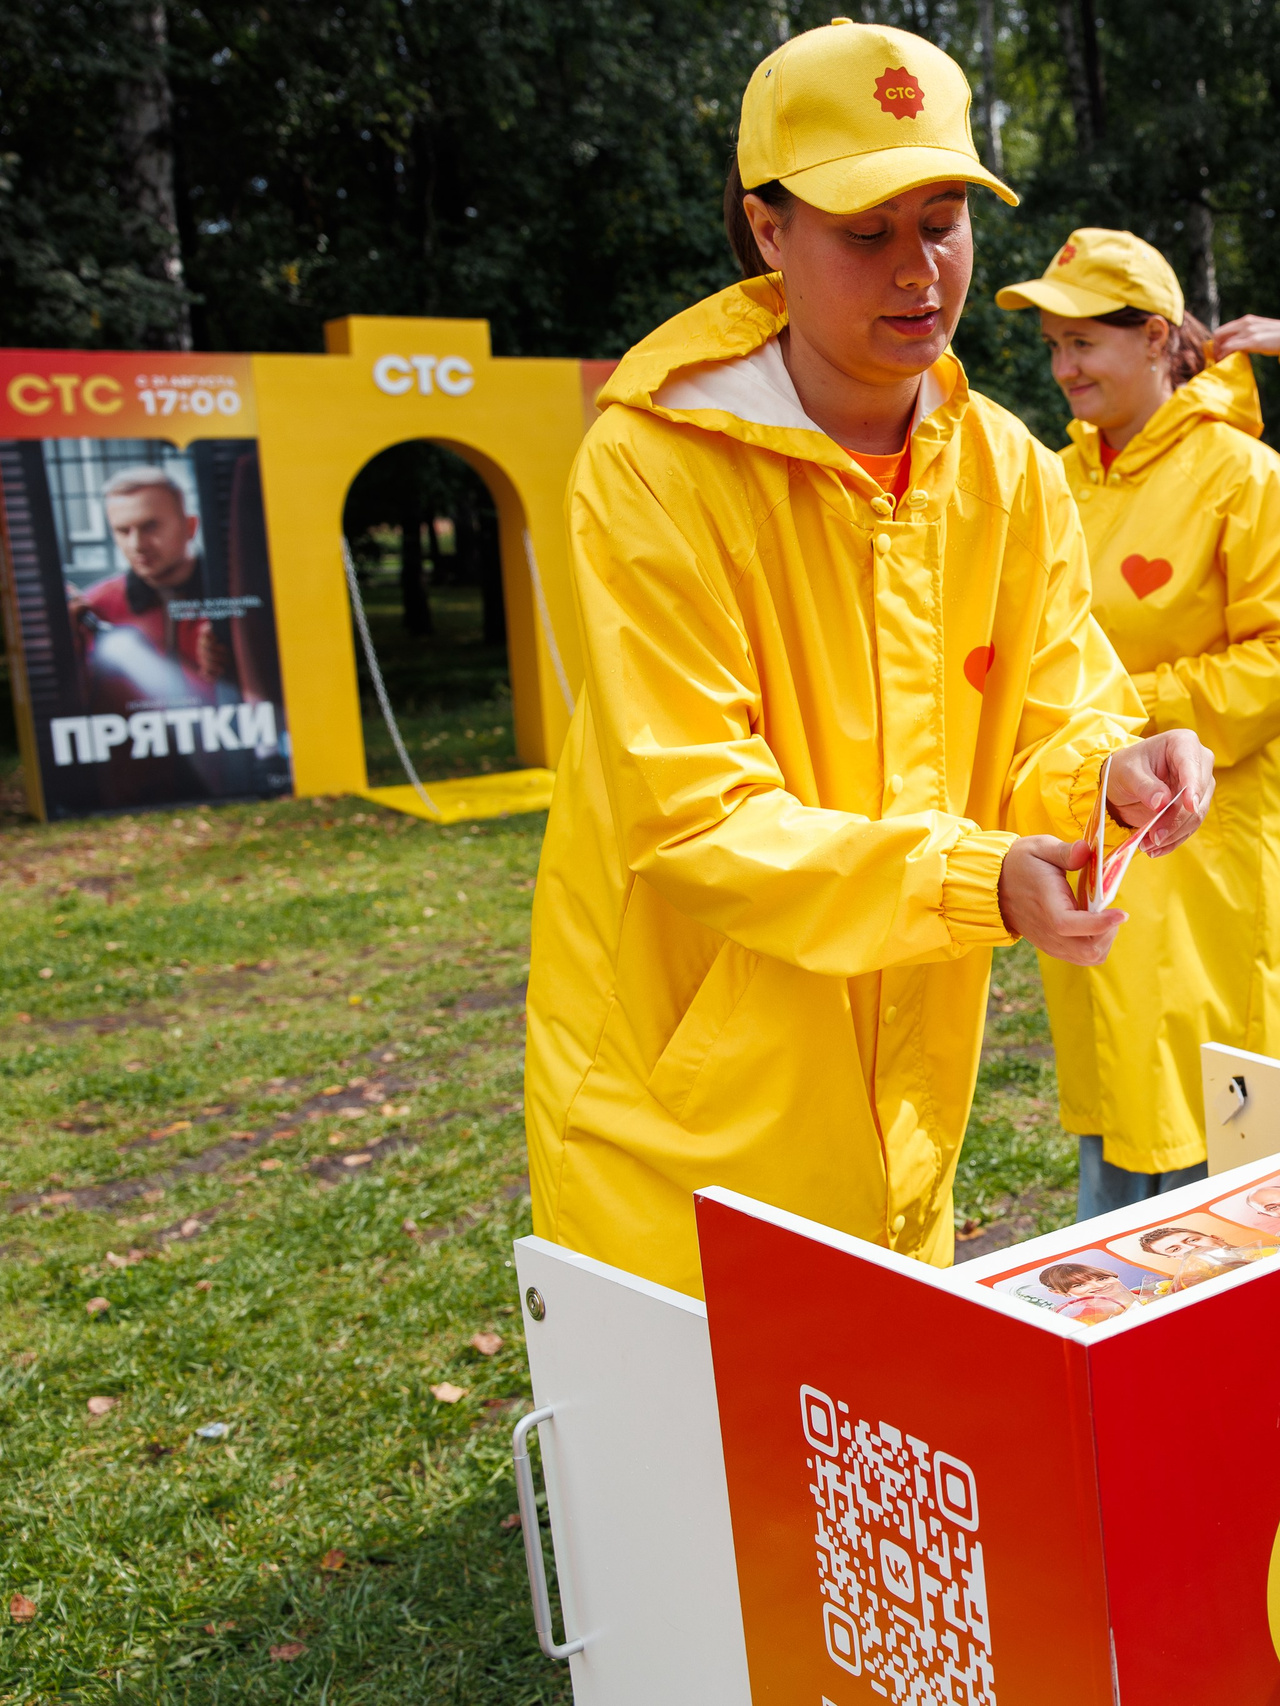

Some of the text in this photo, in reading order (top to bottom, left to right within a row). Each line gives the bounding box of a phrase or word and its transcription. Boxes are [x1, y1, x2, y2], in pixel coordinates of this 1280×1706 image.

[885, 86, 916, 100] СТС
[7, 374, 123, 416] СТС
[373, 355, 475, 396] СТС
[138, 389, 242, 416] 17:00
[51, 701, 277, 767] ПРЯТКИ
